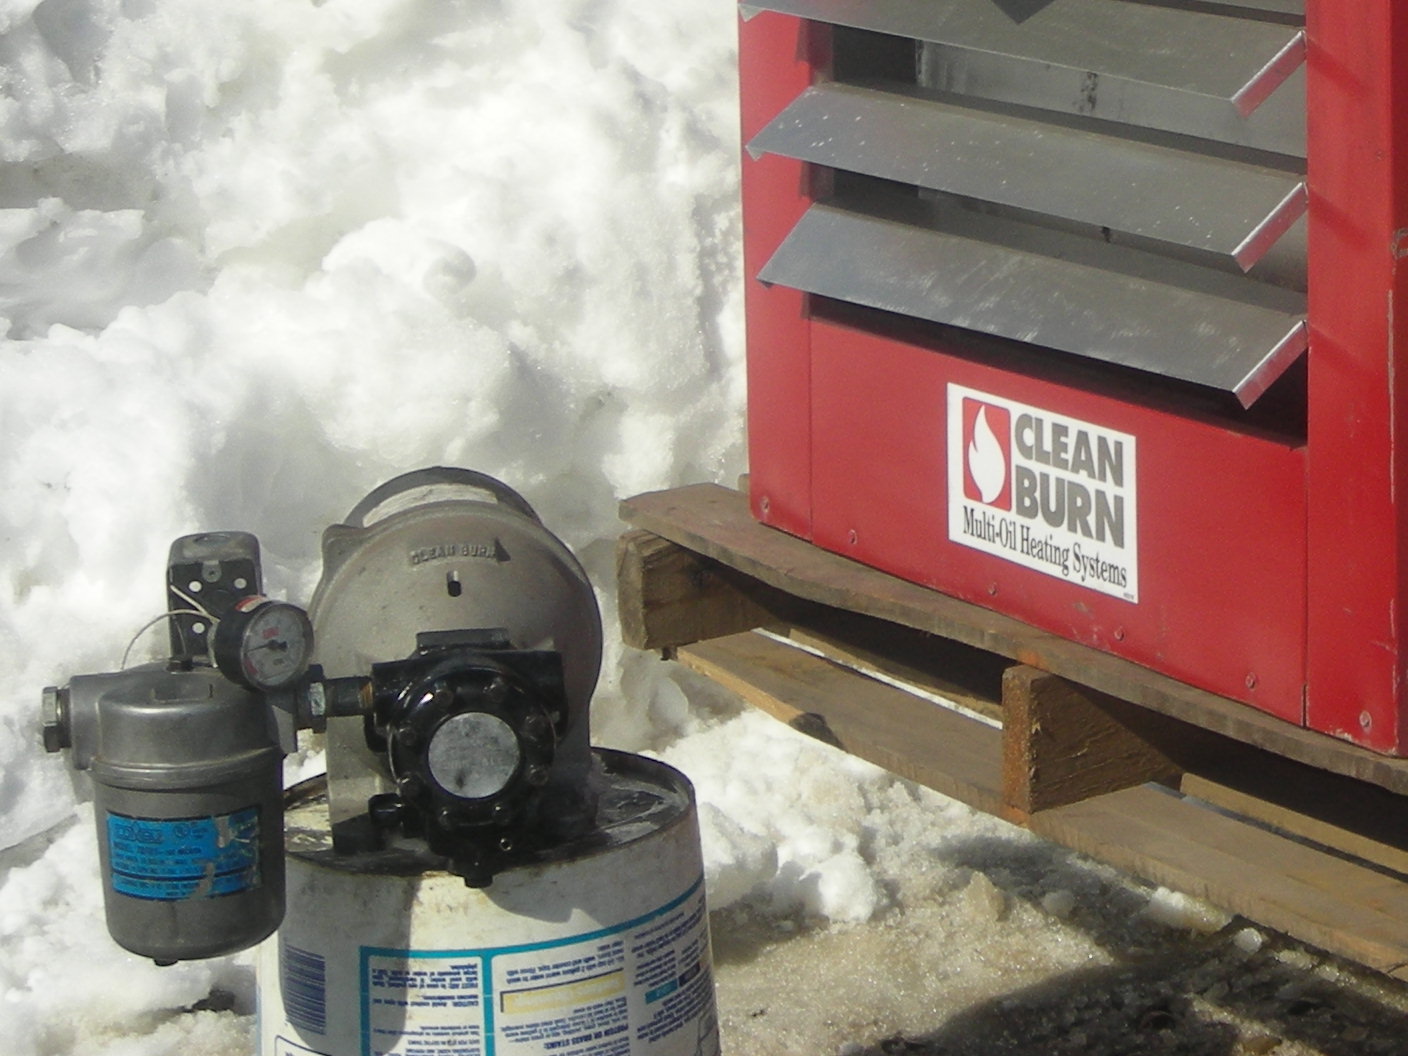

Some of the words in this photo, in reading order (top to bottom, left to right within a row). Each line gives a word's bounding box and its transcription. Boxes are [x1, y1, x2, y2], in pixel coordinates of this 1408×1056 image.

[1015, 413, 1124, 488] CLEAN
[963, 506, 1017, 552] Multi-Oil
[1020, 524, 1070, 577] Heating
[1073, 542, 1127, 588] Systems
[1015, 464, 1125, 550] BURN
